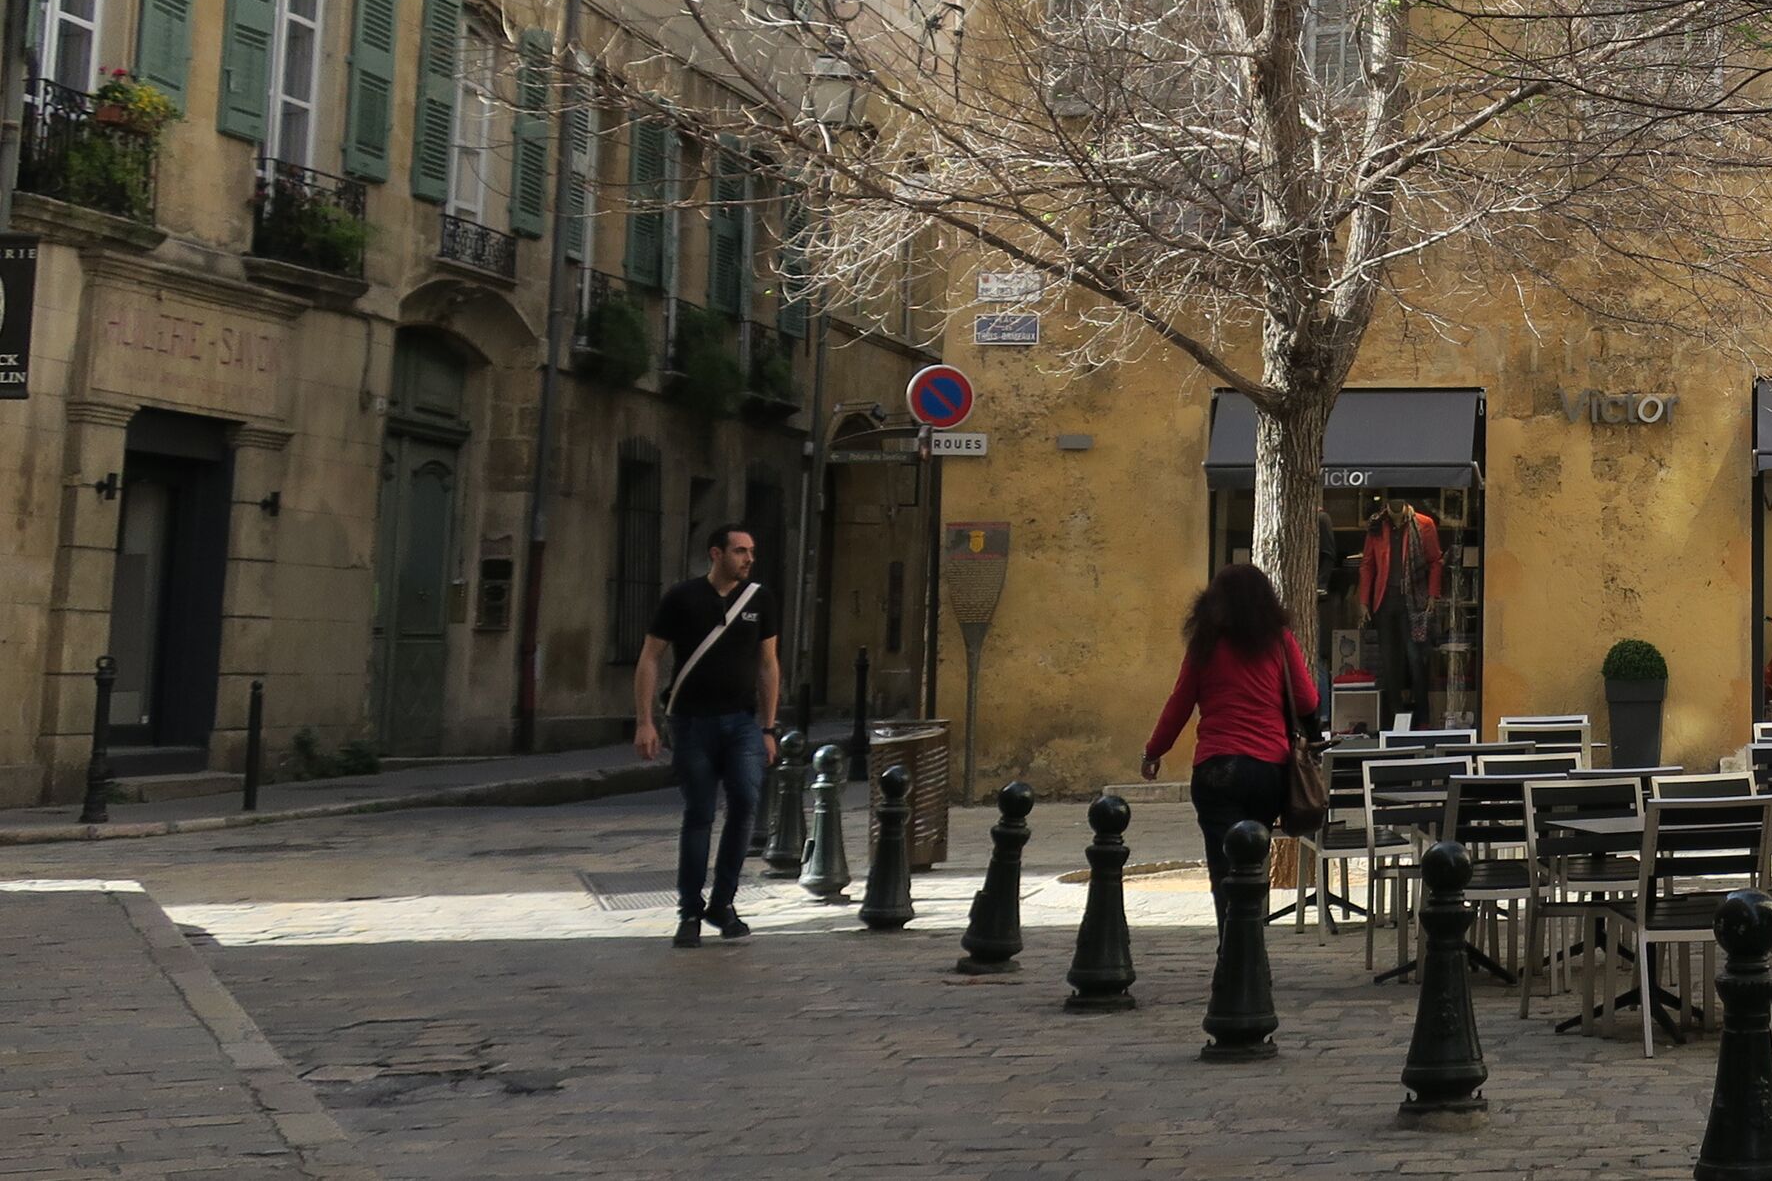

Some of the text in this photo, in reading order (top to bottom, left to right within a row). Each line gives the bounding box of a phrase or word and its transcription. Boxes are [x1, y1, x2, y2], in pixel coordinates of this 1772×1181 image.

[0, 248, 36, 259] RIE
[0, 371, 27, 384] LIN
[1556, 387, 1680, 424] Victor
[933, 439, 982, 450] ROUES
[1318, 467, 1373, 486] ictor
